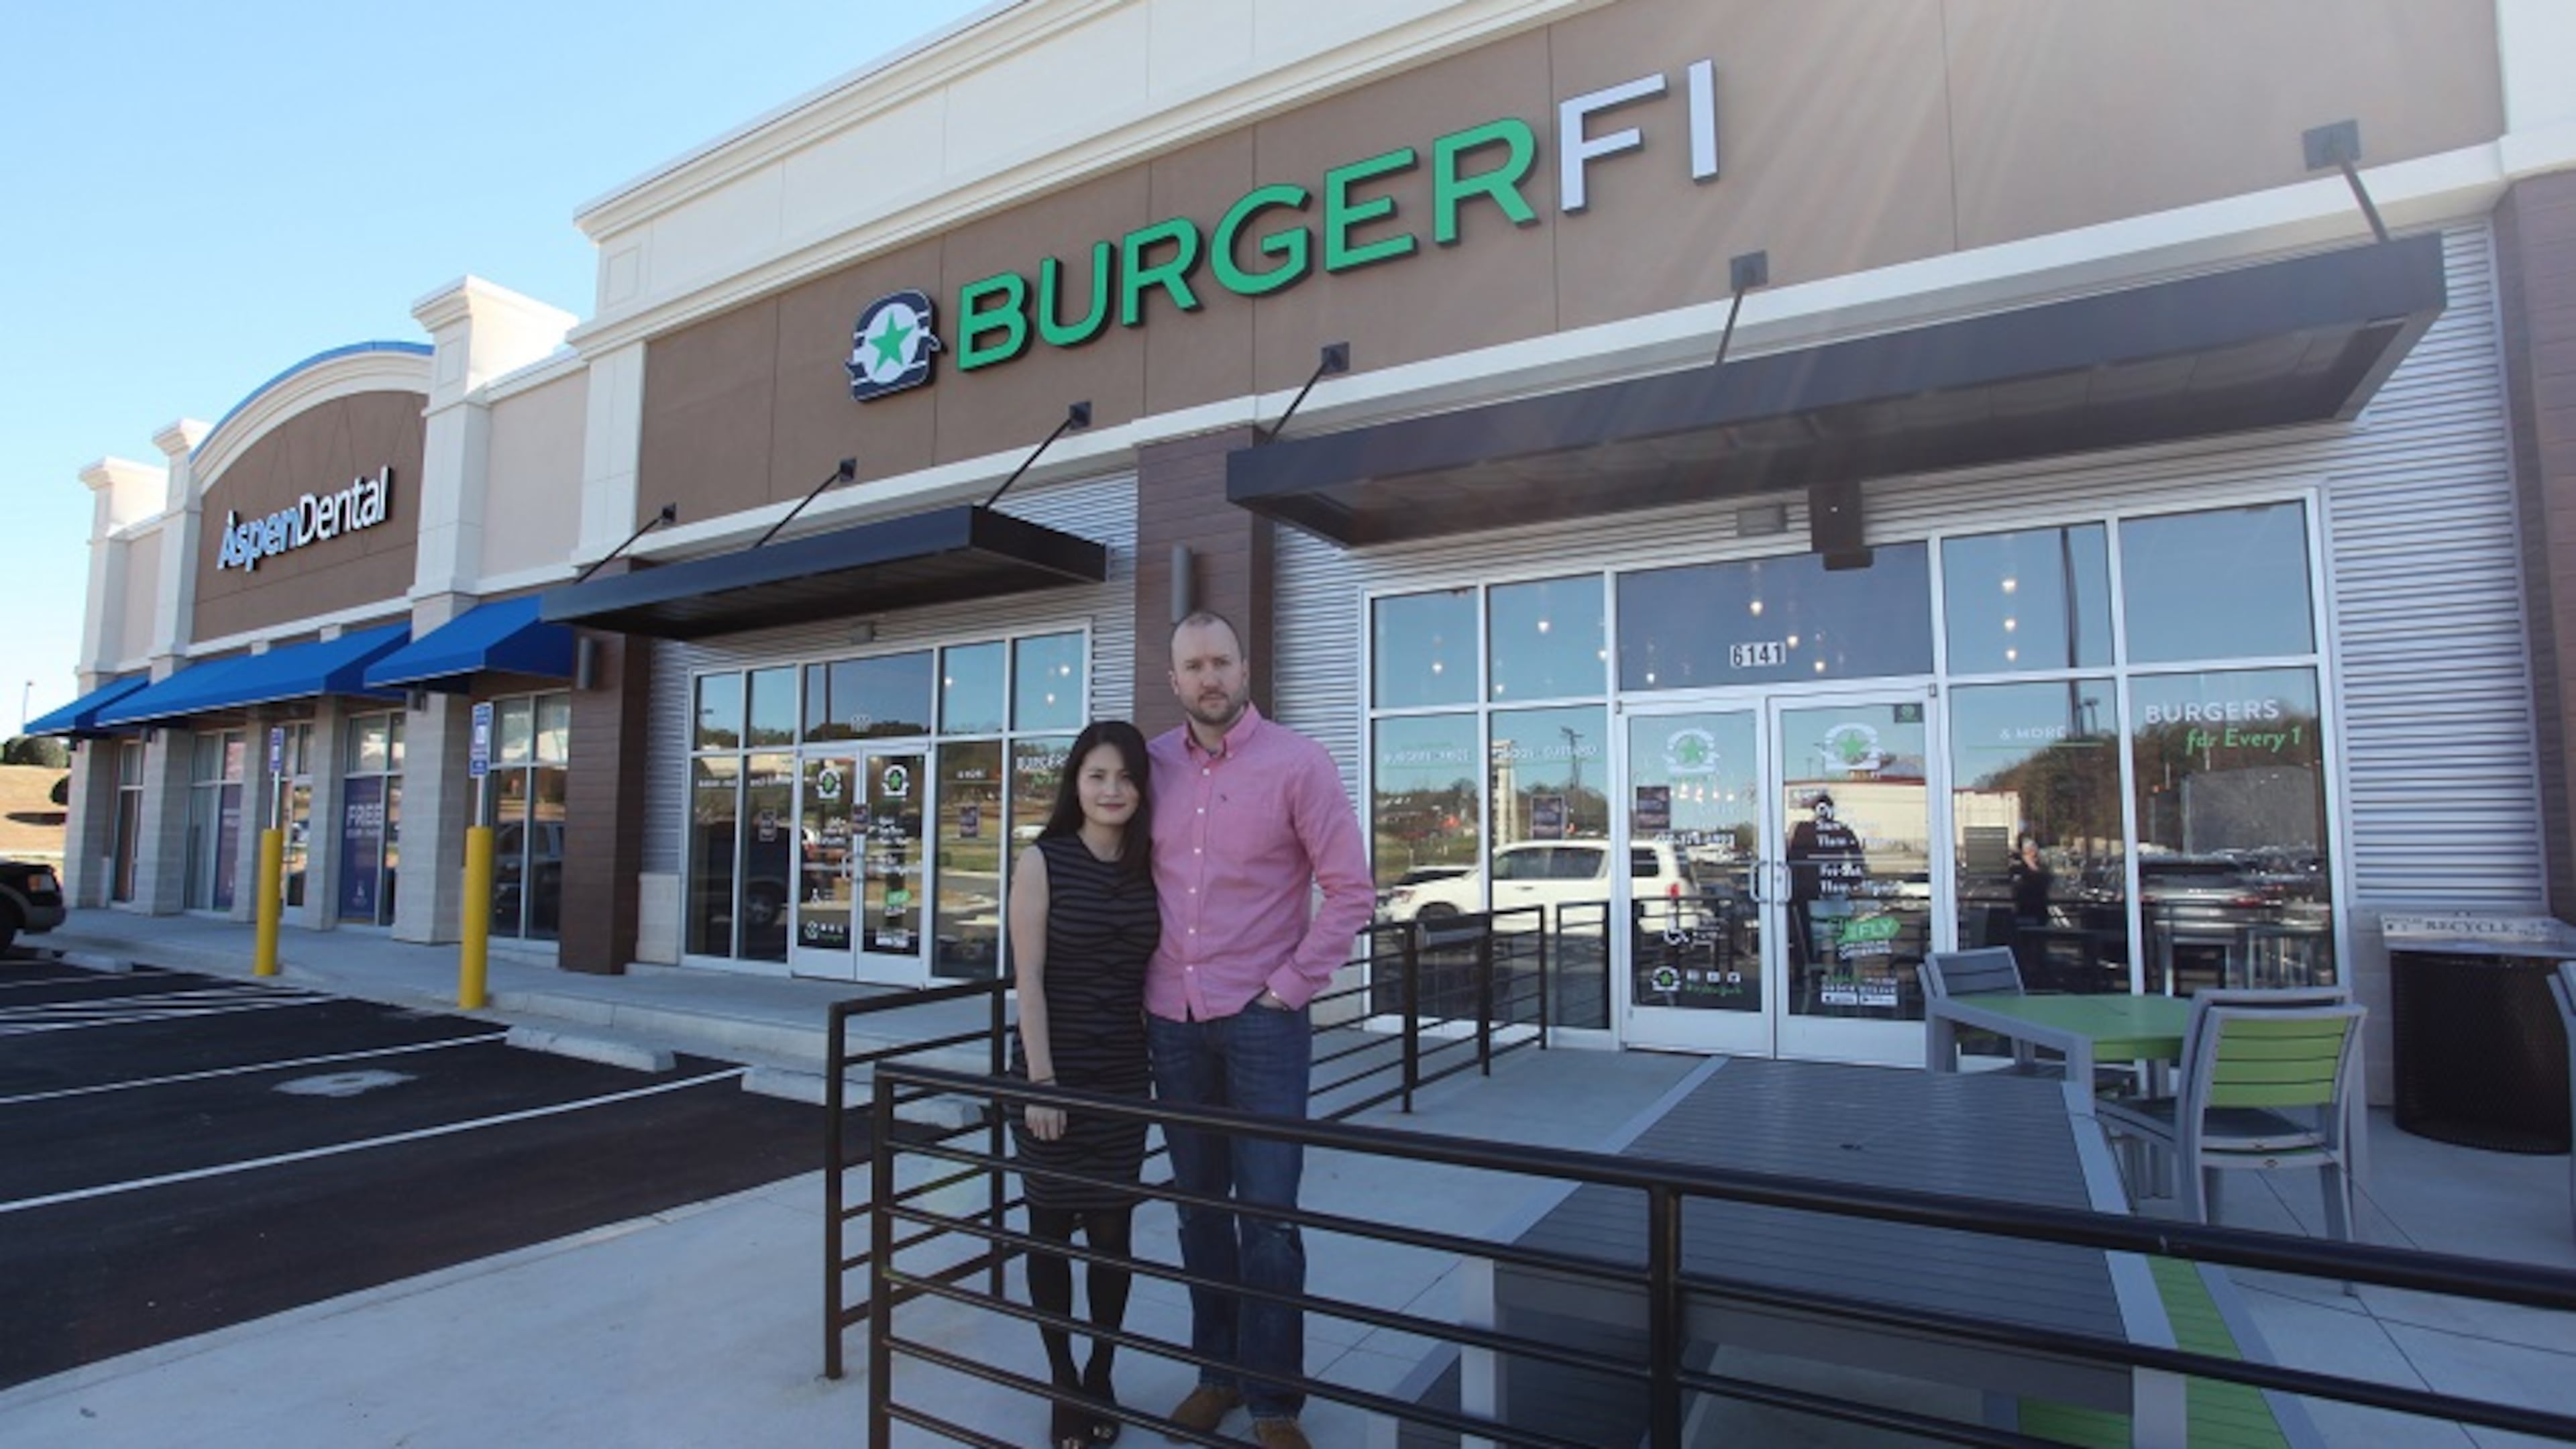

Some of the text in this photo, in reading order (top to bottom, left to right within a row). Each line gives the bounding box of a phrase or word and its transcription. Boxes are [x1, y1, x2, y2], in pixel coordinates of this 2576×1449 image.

[957, 58, 1719, 373] BURGERFI
[1733, 645, 1781, 666] 6141
[2145, 699, 2280, 724] BURGERS
[2016, 725, 2067, 739] MORE
[2225, 728, 2286, 753] Every
[2292, 725, 2302, 745] 1
[346, 805, 382, 828] FREE
[1859, 920, 1893, 938] FLY
[2426, 920, 2514, 933] RECYCLE
